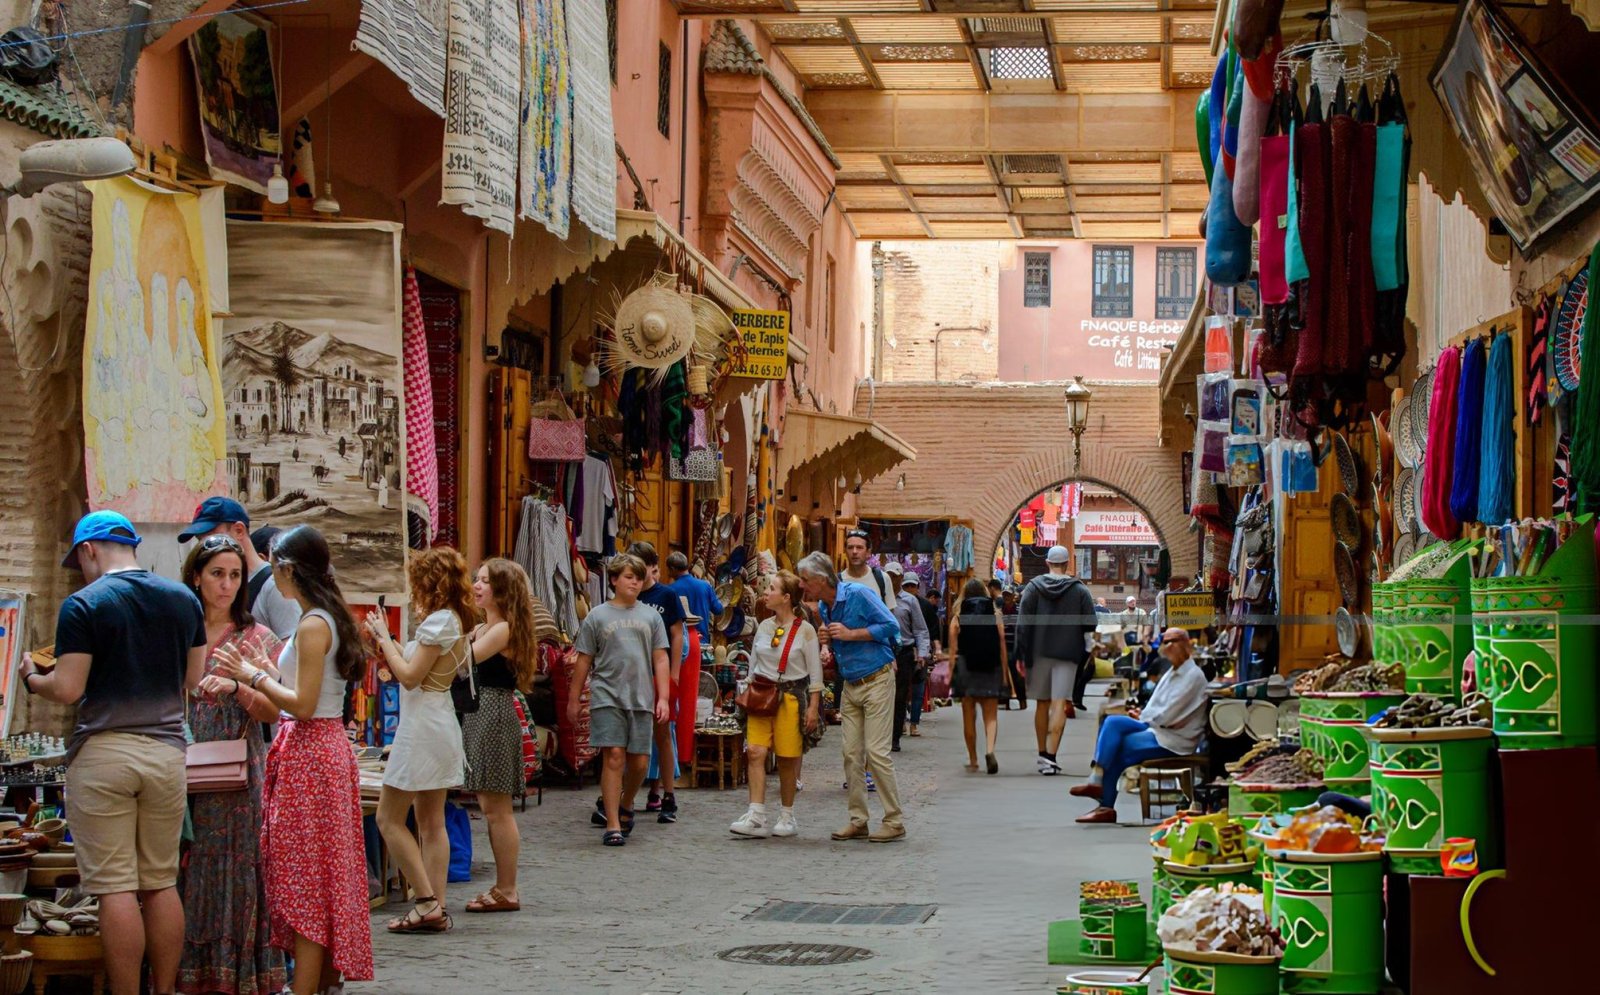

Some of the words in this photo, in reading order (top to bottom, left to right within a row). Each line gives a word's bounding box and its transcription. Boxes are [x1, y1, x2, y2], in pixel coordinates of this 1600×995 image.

[733, 313, 784, 329] BERBERE
[1080, 320, 1137, 333] FNAQUE
[622, 323, 642, 356] Home
[644, 334, 681, 360] Sweet
[743, 330, 756, 343] de
[759, 331, 784, 347] Tapis
[1087, 335, 1131, 348] Café
[733, 345, 784, 356] mdernes
[1114, 350, 1133, 368] Café
[749, 364, 759, 375] 42
[761, 365, 771, 376] 65
[773, 366, 783, 377] 20
[1100, 514, 1138, 523] FNAQUE
[1085, 524, 1103, 533] Café
[1105, 524, 1143, 533] Littéraire
[1170, 597, 1177, 607] LA
[1179, 597, 1197, 607] CROIX
